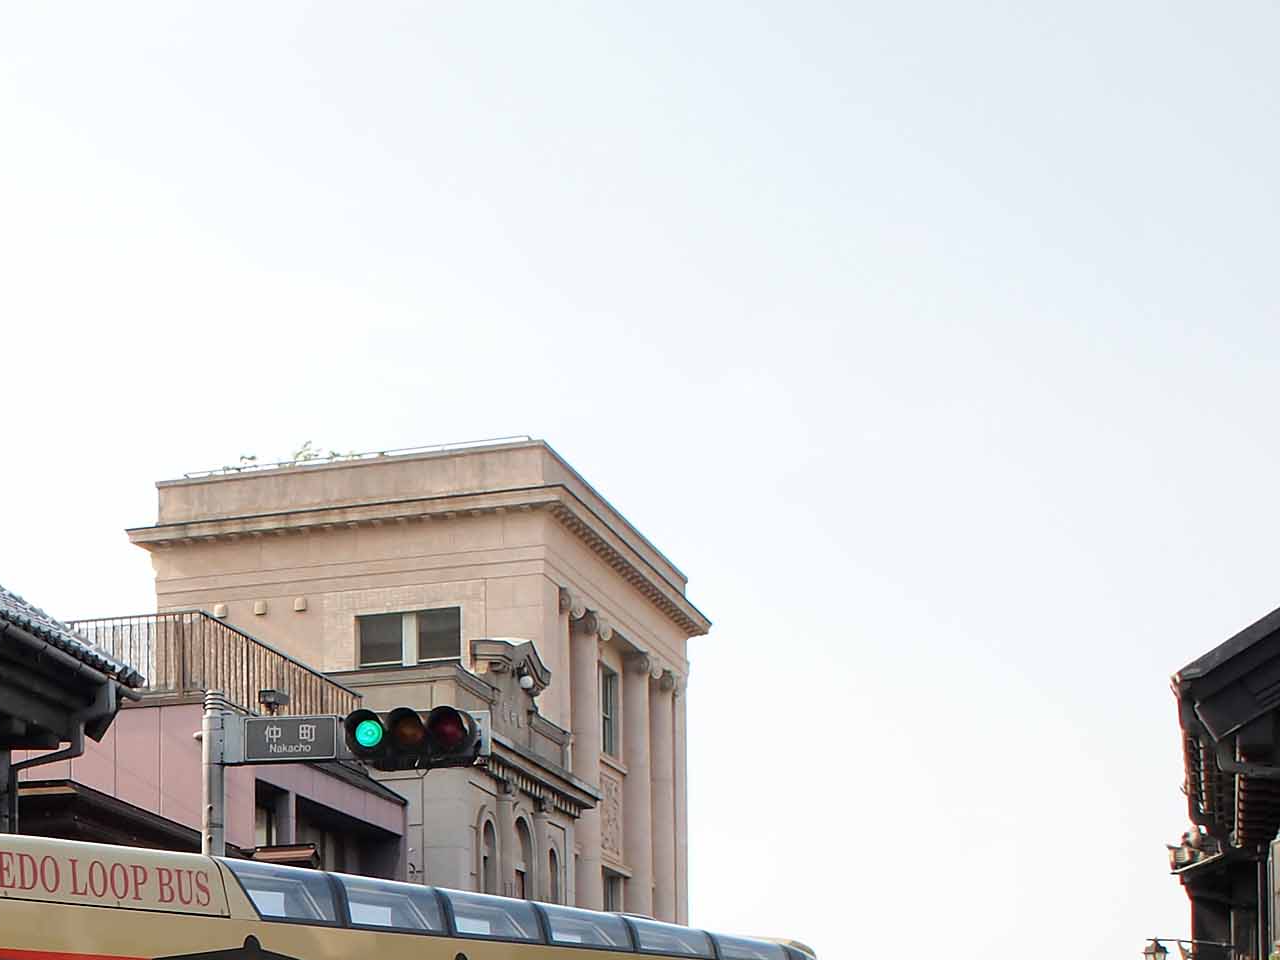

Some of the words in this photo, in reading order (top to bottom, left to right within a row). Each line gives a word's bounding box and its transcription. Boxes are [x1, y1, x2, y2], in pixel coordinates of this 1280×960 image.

[264, 724, 317, 743] 仲町
[269, 743, 312, 753] Nakacho
[69, 858, 148, 900] LOOP
[156, 867, 211, 906] BUS
